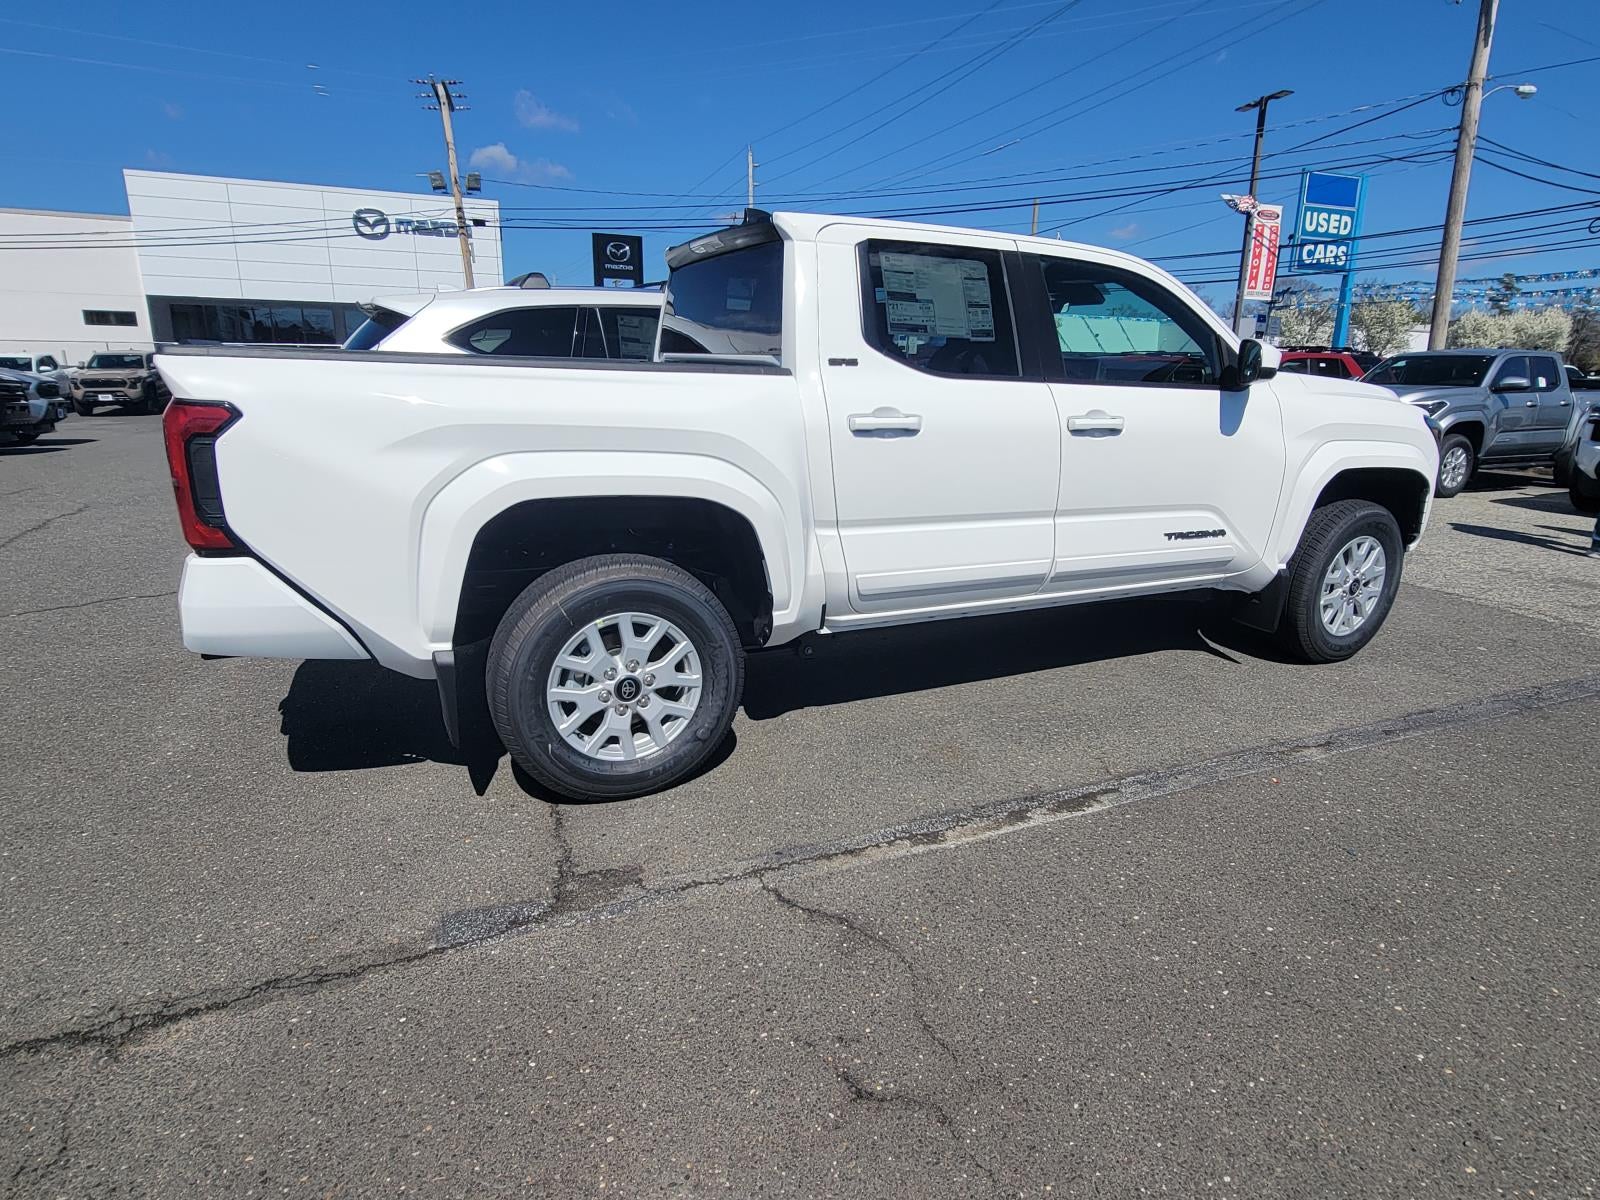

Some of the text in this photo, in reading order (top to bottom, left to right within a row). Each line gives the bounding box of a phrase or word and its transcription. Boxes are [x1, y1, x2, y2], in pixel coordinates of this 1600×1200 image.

[1305, 211, 1352, 235] USED
[1249, 226, 1263, 289] TOYOTA
[1302, 243, 1347, 266] CARS
[604, 263, 634, 271] mazda
[1163, 529, 1226, 541] TACOMA
